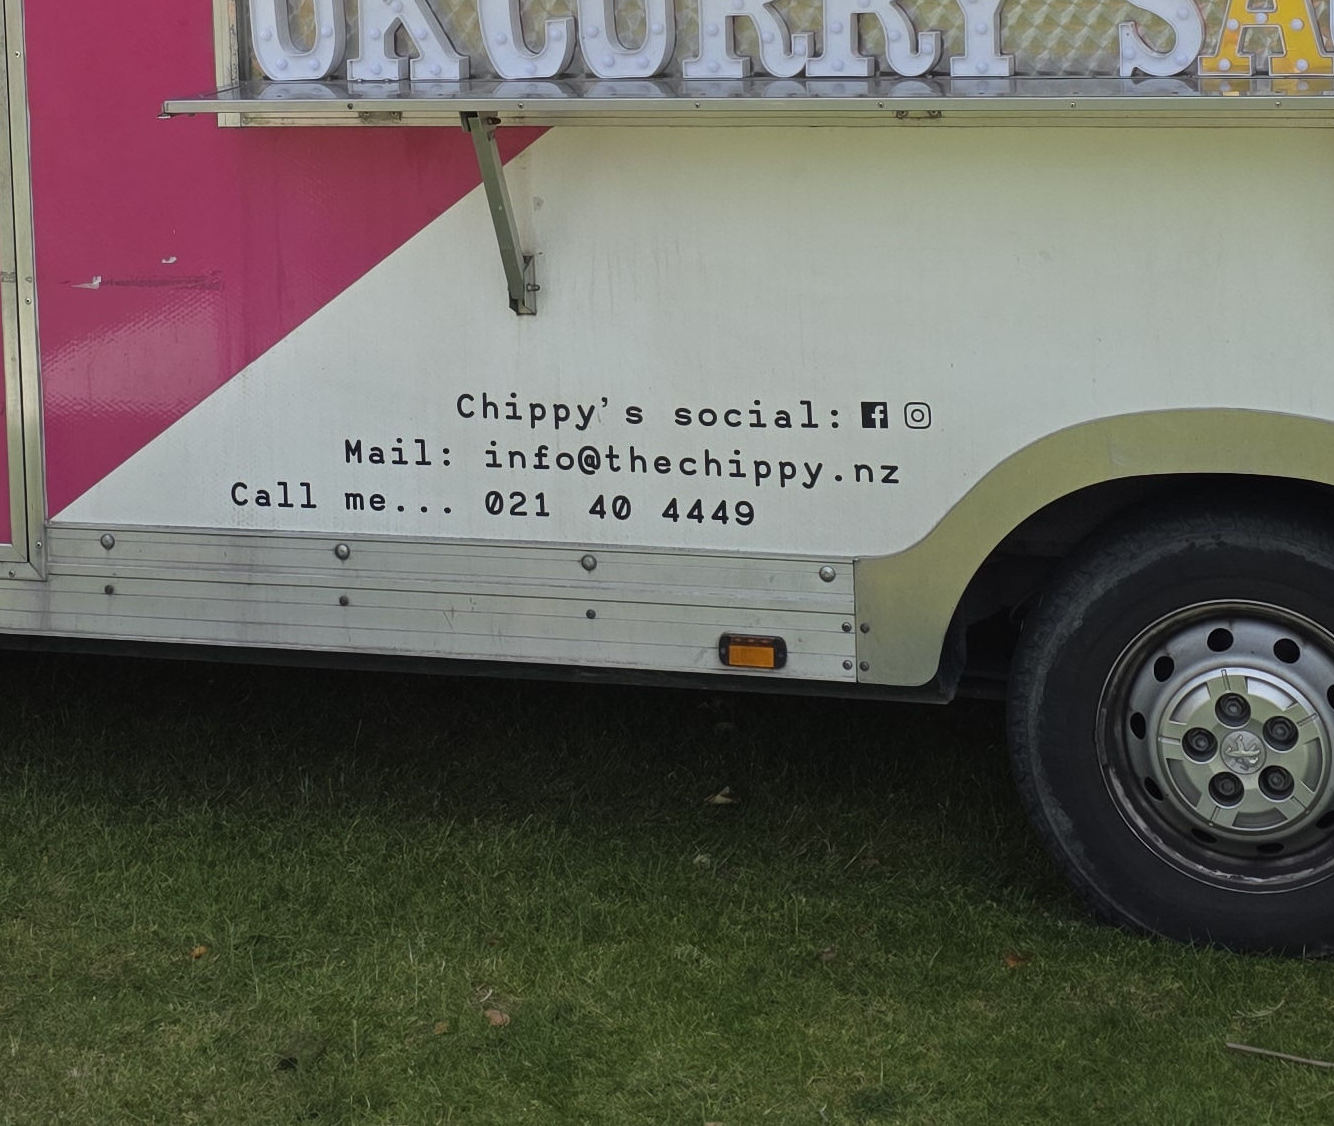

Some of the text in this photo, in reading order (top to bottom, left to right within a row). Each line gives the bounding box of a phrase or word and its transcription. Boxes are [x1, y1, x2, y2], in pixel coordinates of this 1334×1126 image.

[457, 392, 841, 432] Chippy's social:
[344, 439, 901, 490] Mail: info@thechippy.nz
[230, 481, 756, 526] Call me... 021 40 4449
